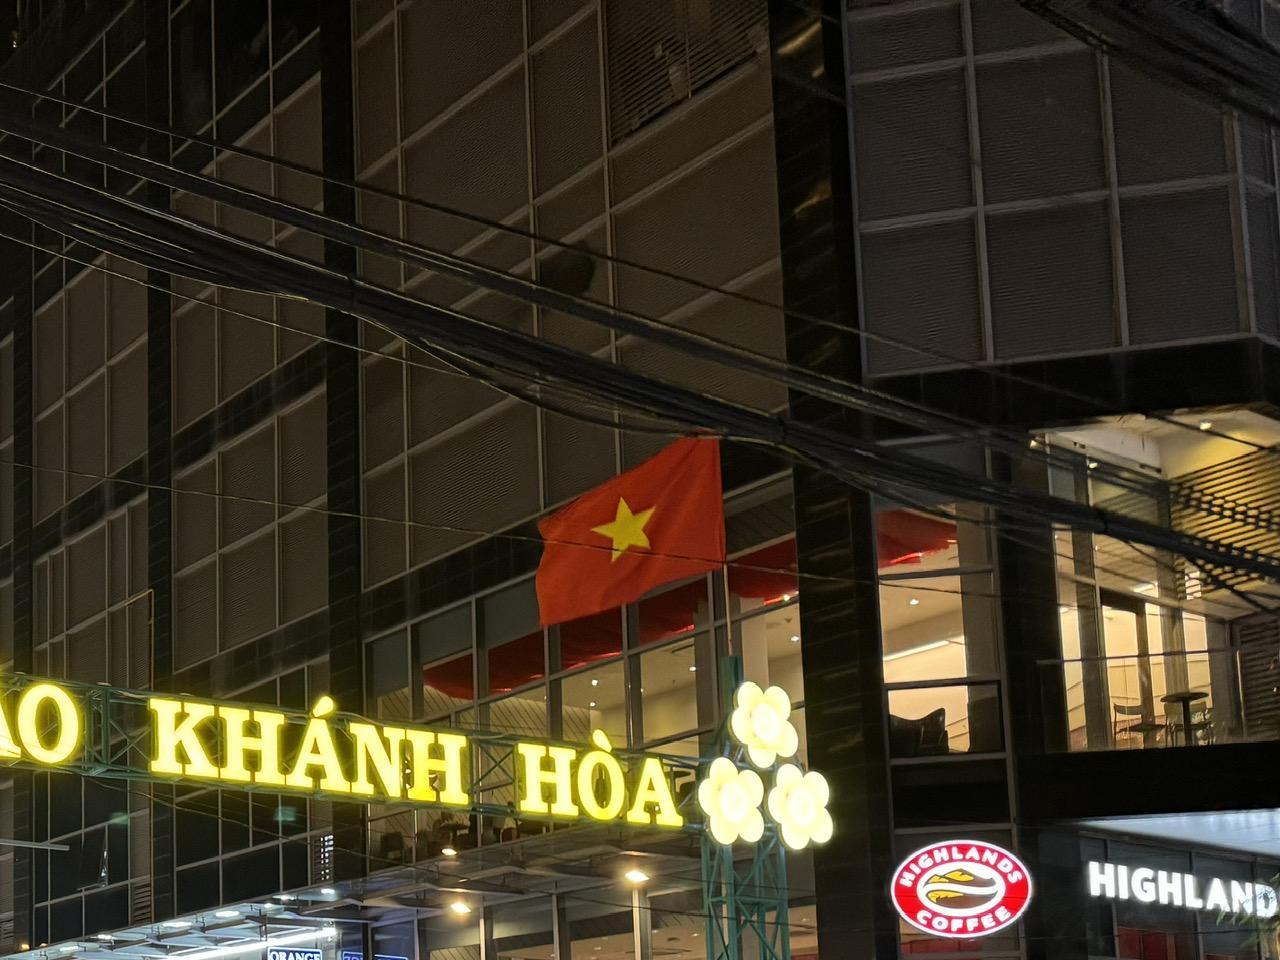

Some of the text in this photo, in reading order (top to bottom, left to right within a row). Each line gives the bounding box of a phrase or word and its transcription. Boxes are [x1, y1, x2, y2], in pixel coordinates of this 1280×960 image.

[148, 696, 471, 808] KHÁNH
[517, 729, 685, 829] HÒA
[898, 842, 1023, 890] HIGHLANDS
[915, 903, 1012, 933] COFFEE
